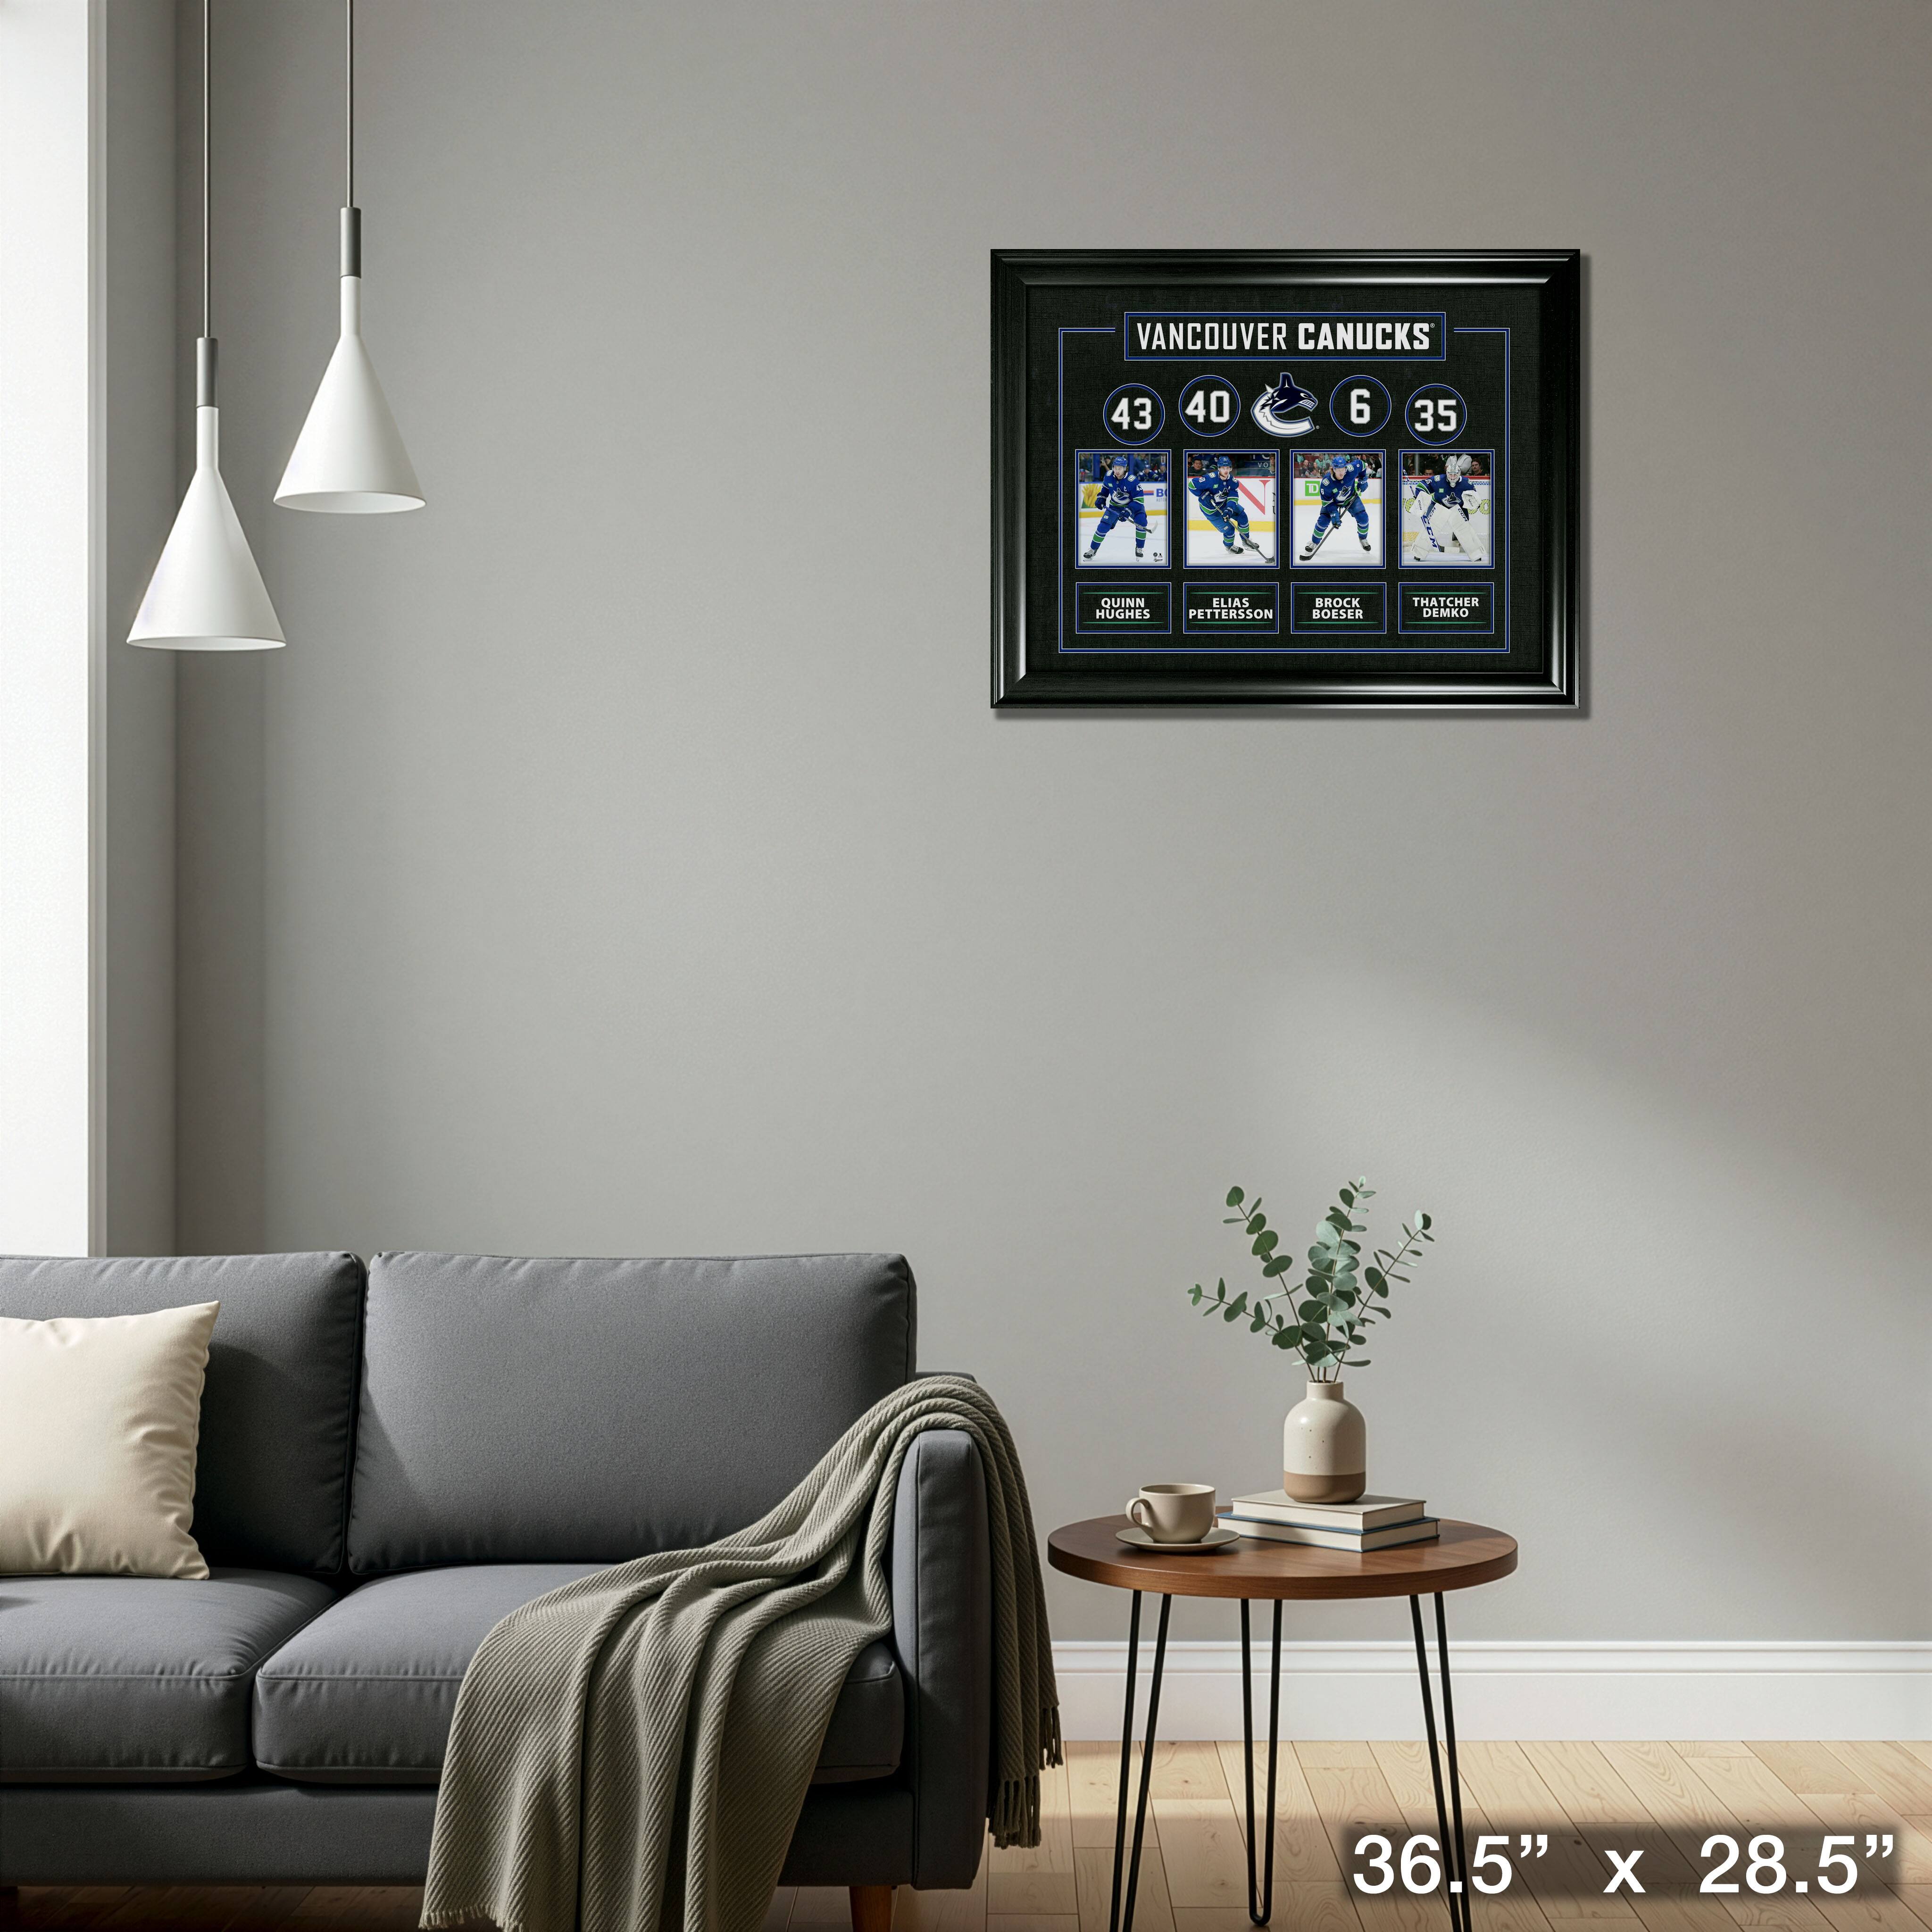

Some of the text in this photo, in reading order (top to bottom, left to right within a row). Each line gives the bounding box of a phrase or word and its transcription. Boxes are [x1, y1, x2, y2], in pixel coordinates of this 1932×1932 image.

[1137, 323, 1287, 350] VANCOUVER
[1184, 390, 1230, 423] 40
[1350, 389, 1370, 424] 6
[1110, 397, 1152, 430] 43
[1414, 400, 1457, 432] 35
[1136, 483, 1143, 491] 43
[1306, 483, 1319, 493] TD
[1458, 508, 1468, 522] CCM
[1423, 514, 1438, 549] CCM
[1101, 598, 1145, 608] QUINN
[1213, 598, 1249, 608] ELIAS
[1316, 598, 1360, 608] BROCK
[1412, 597, 1479, 607] THATCHER
[1096, 609, 1150, 619] HUGHES
[1189, 609, 1273, 619] PETTERSSON
[1312, 609, 1363, 619] BOESER
[1423, 608, 1469, 617] DEMKO
